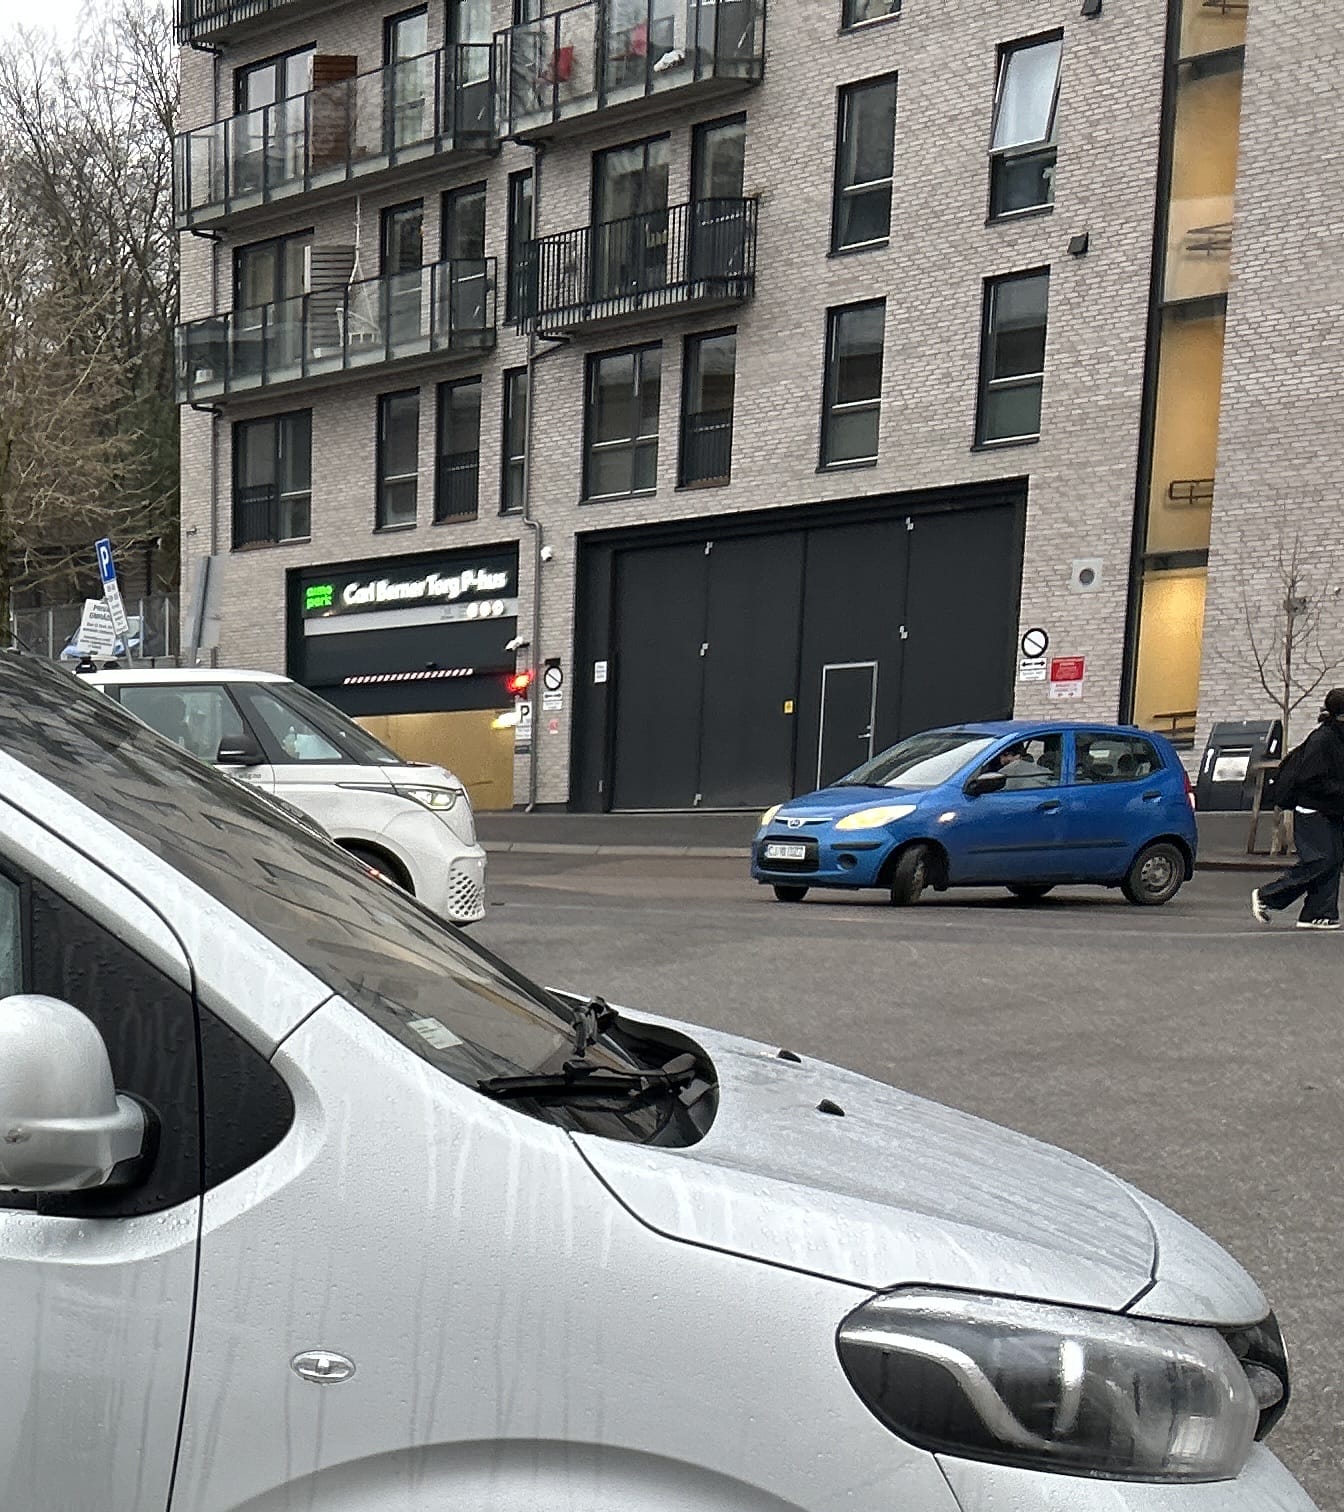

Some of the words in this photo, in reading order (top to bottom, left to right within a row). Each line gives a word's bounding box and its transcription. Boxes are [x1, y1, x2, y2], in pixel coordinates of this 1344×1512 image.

[99, 546, 110, 577] P
[343, 581, 376, 605] Carl
[376, 578, 427, 602] Berner
[426, 573, 461, 600] Torg
[461, 568, 509, 592] P-hus
[520, 705, 530, 723] P
